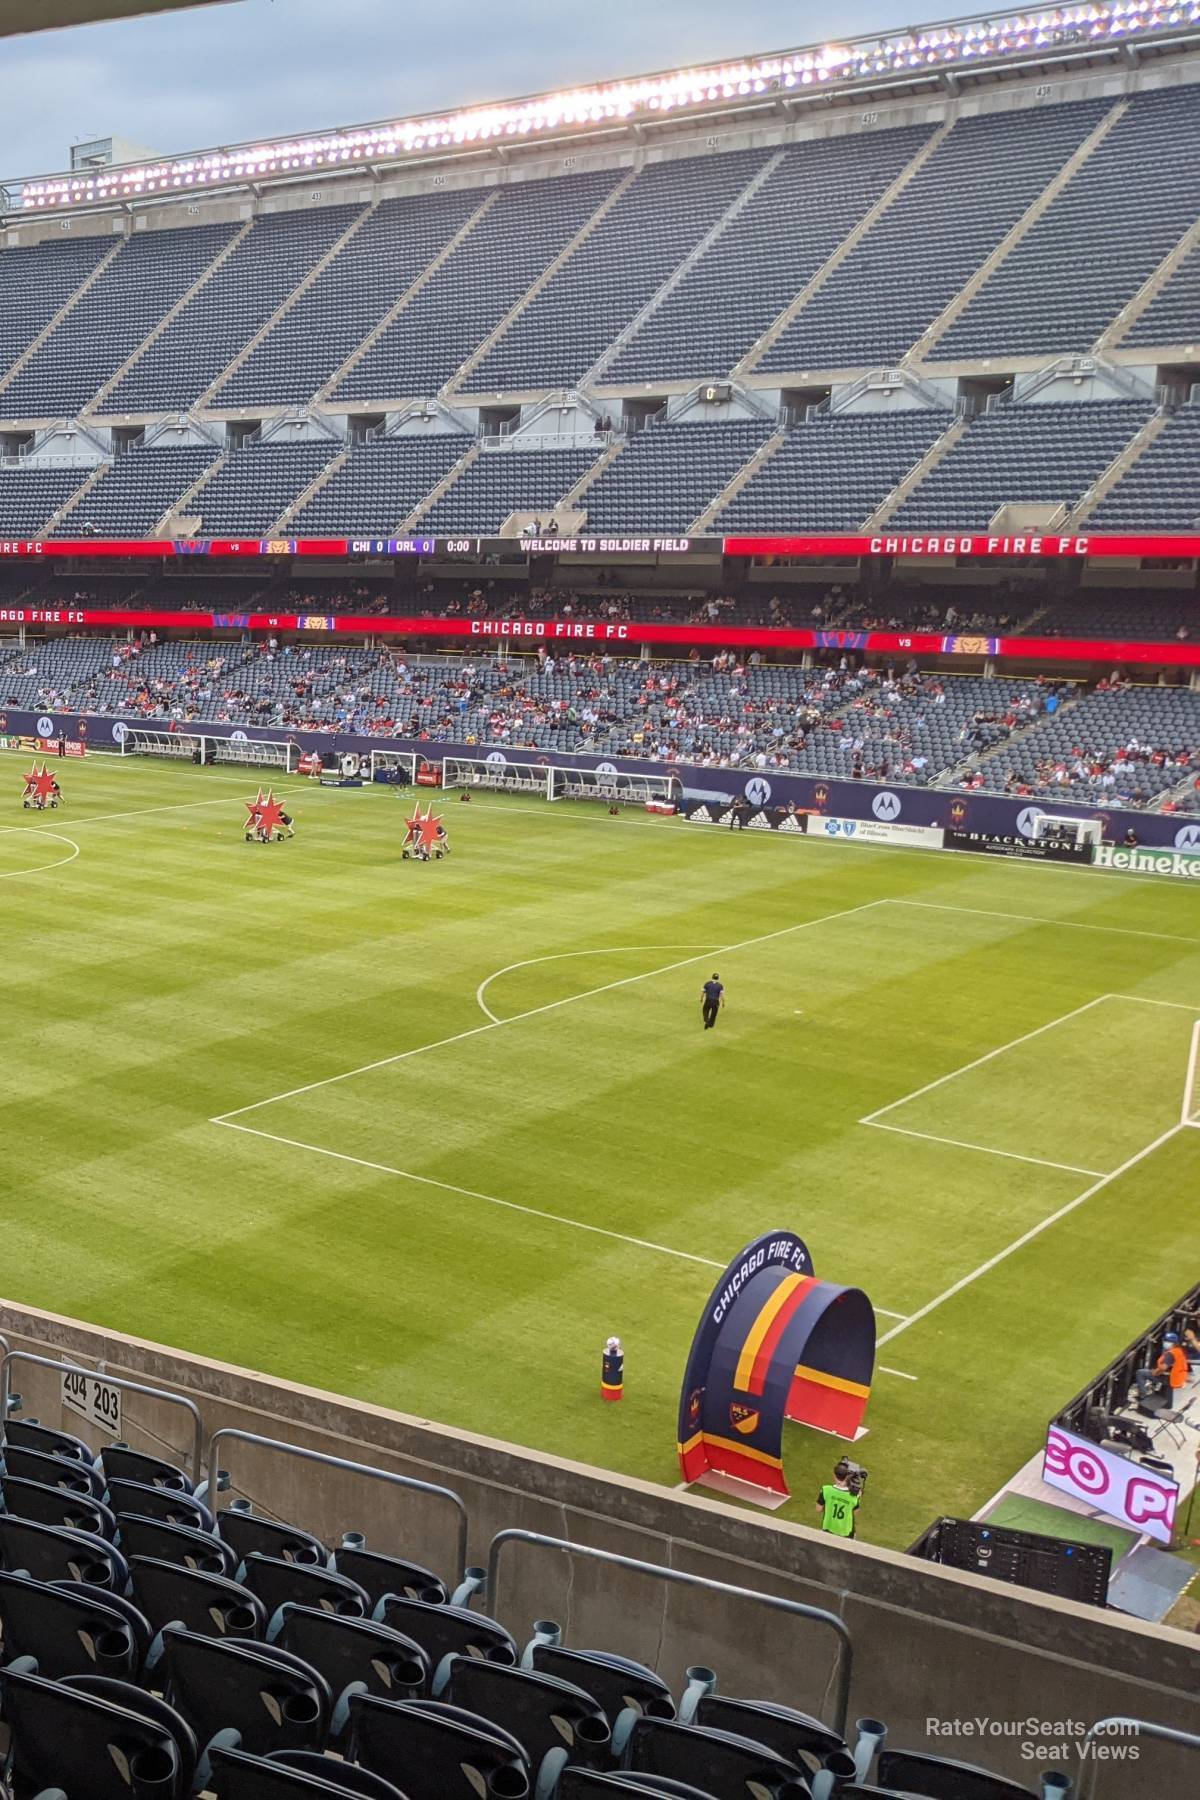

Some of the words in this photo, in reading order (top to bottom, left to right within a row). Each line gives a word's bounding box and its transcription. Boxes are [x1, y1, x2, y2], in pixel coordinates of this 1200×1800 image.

[27, 542, 42, 554] FC
[353, 542, 370, 551] CHI
[376, 542, 383, 552] 0
[396, 542, 416, 551] ORL
[423, 542, 429, 552] 0
[448, 542, 469, 552] 0:00
[520, 540, 576, 550] WELCOME
[581, 540, 596, 550] TO
[600, 540, 650, 550] SOLDIER
[654, 540, 688, 550] FIELD
[870, 538, 972, 553] CHICAGO
[988, 538, 1043, 553] FIRE
[1058, 538, 1089, 554] FC
[32, 611, 60, 622] FIRE
[69, 612, 84, 623] FC
[472, 622, 545, 636] CHICAGO
[556, 624, 595, 637] FIRE
[606, 624, 628, 638] FC
[898, 639, 912, 648] VS
[970, 833, 1083, 851] BLACKSTONE
[712, 1248, 764, 1324] CHICAGO
[767, 1241, 792, 1261] FIRE
[791, 1248, 806, 1270] FC
[94, 1382, 118, 1420] 203
[732, 1405, 748, 1416] MLS
[832, 1504, 845, 1520] 16
